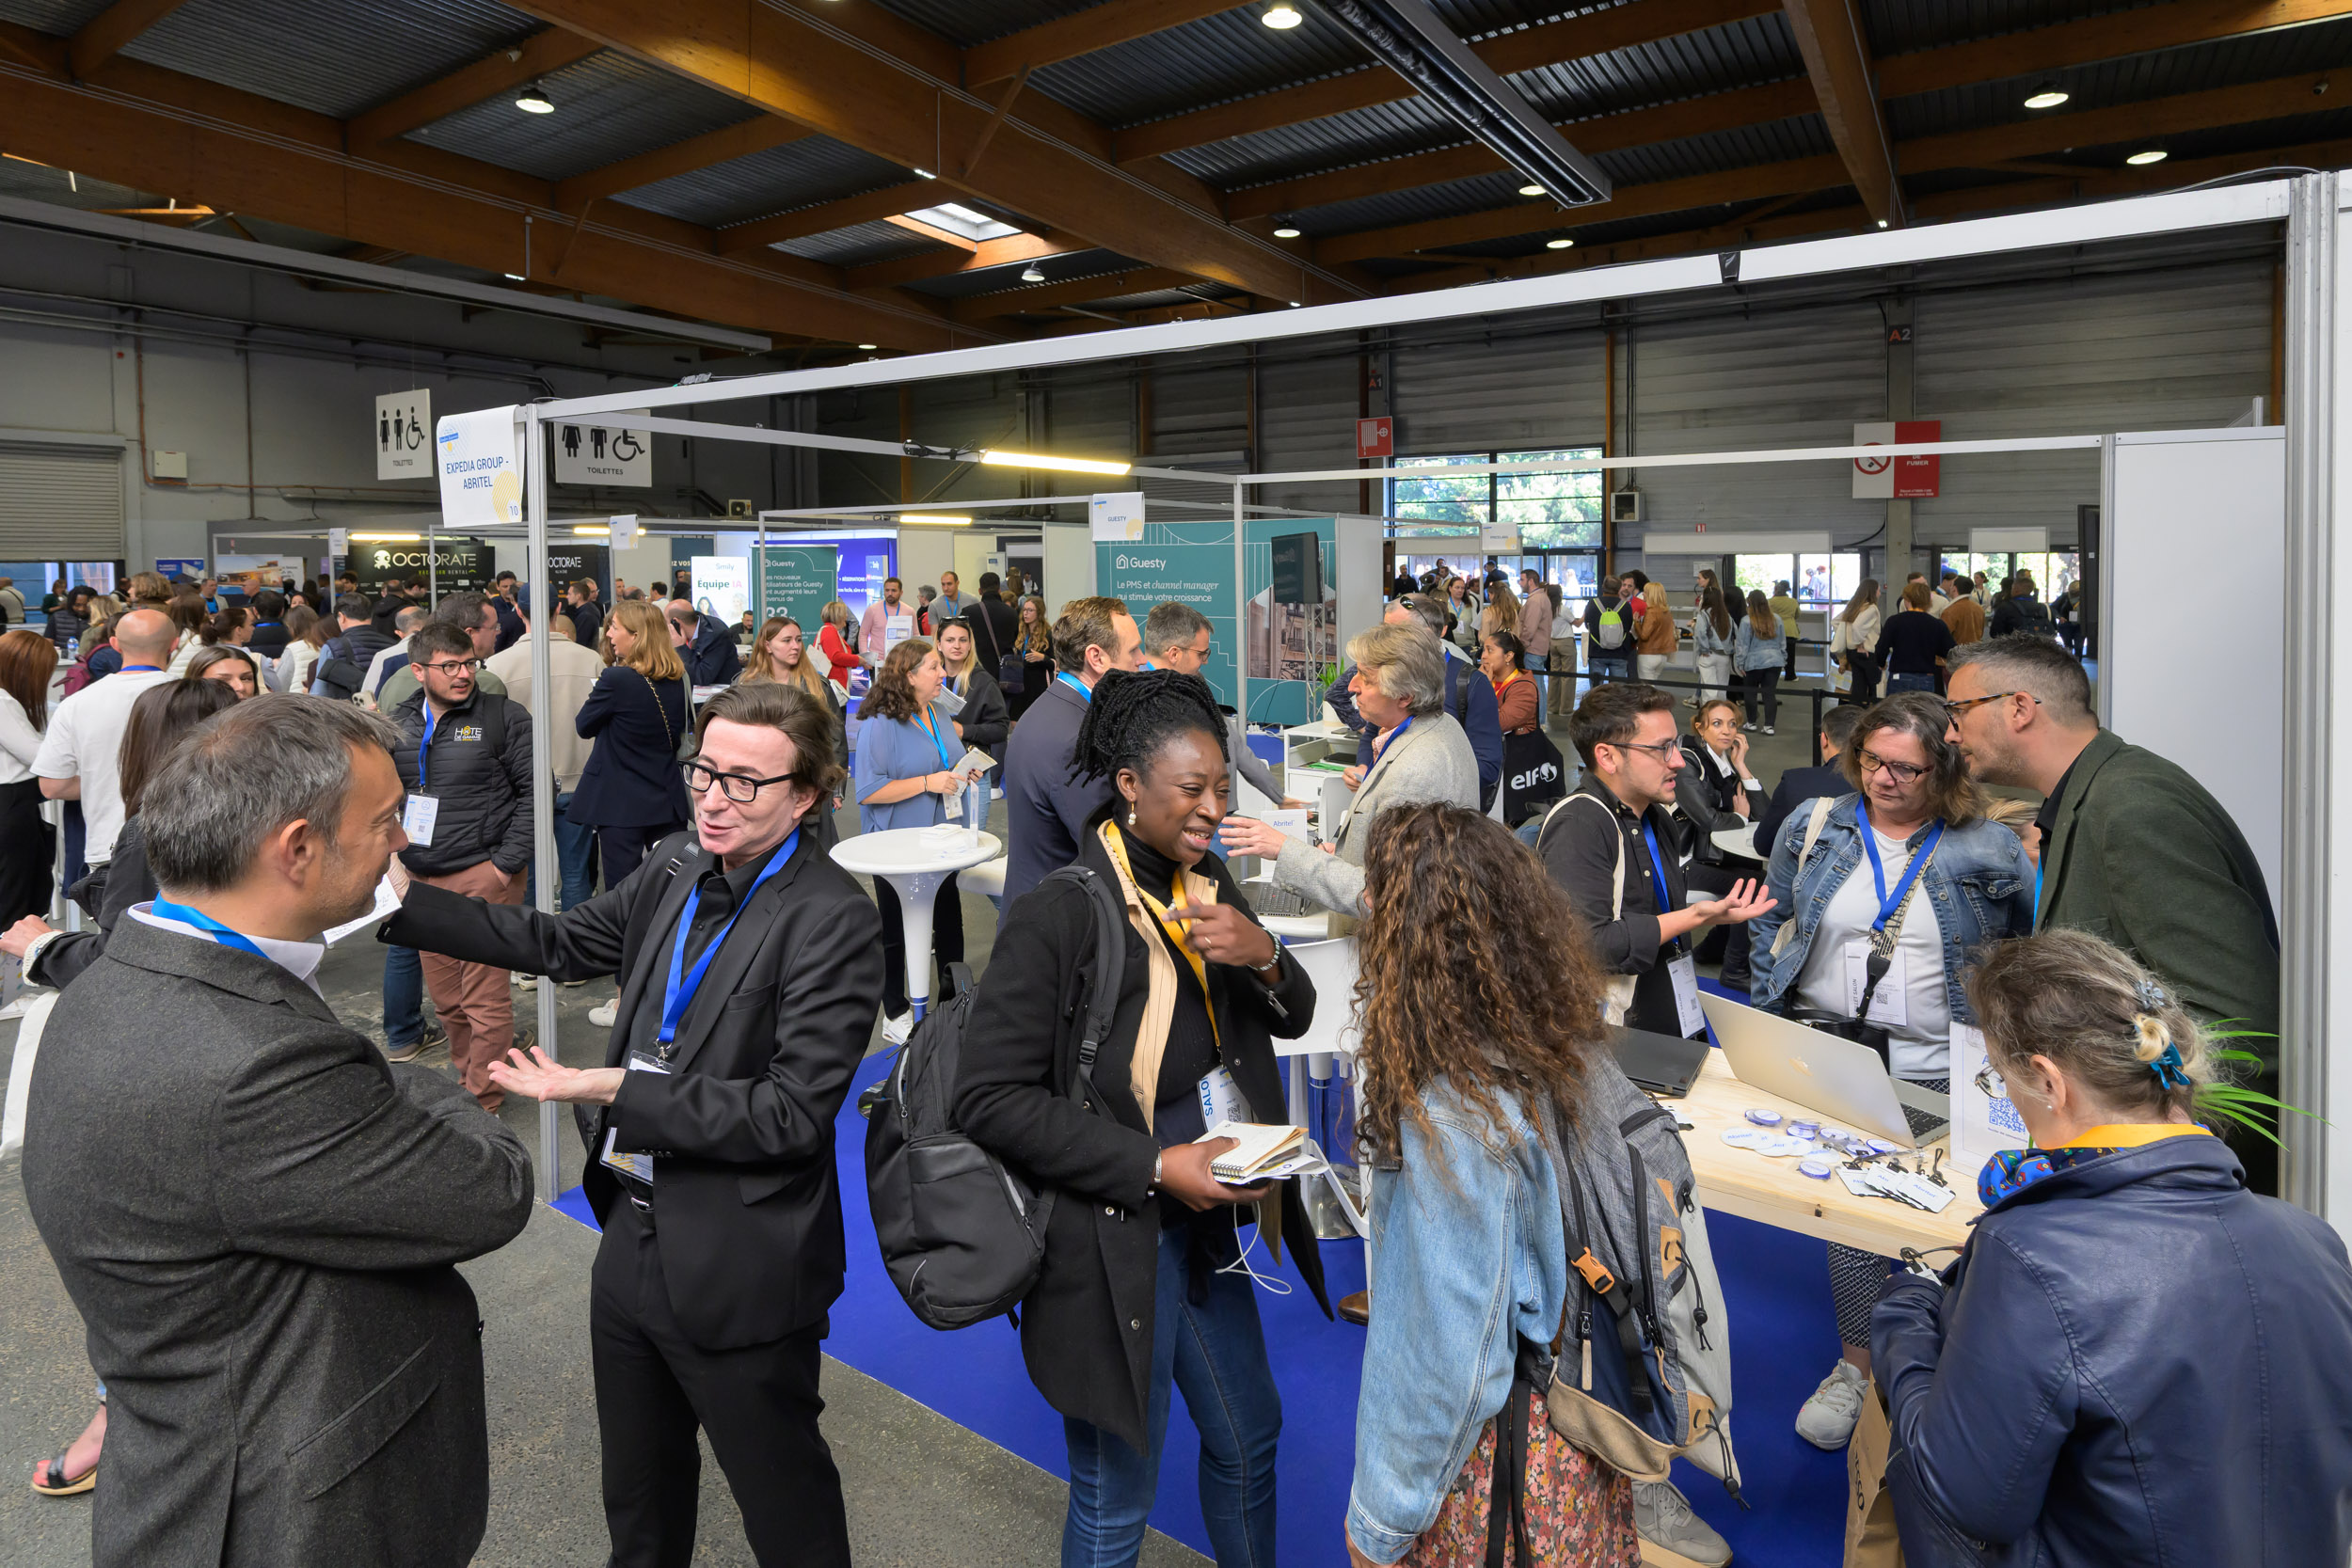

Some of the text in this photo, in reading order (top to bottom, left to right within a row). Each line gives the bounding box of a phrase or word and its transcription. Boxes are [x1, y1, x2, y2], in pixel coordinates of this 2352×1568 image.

[1889, 328, 1911, 341] A2
[1369, 378, 1382, 388] A1
[446, 459, 475, 474] EXPEDIA
[476, 456, 503, 470] GROUP
[587, 467, 623, 475] TOILETTES
[463, 476, 493, 489] ABRITEL
[510, 506, 518, 515] 10
[392, 553, 476, 566] OCTORATE
[548, 557, 581, 567] OCTORATE
[771, 560, 795, 568] Guesty
[1130, 557, 1167, 571] Guesty
[715, 562, 735, 571] Smily
[697, 578, 742, 590] Équipe IA
[1152, 580, 1183, 589] channel
[1184, 582, 1219, 592] manager
[1117, 593, 1128, 601] qui
[1129, 593, 1153, 601] stimule
[1173, 594, 1212, 602] croissance
[1511, 768, 1539, 790] elf
